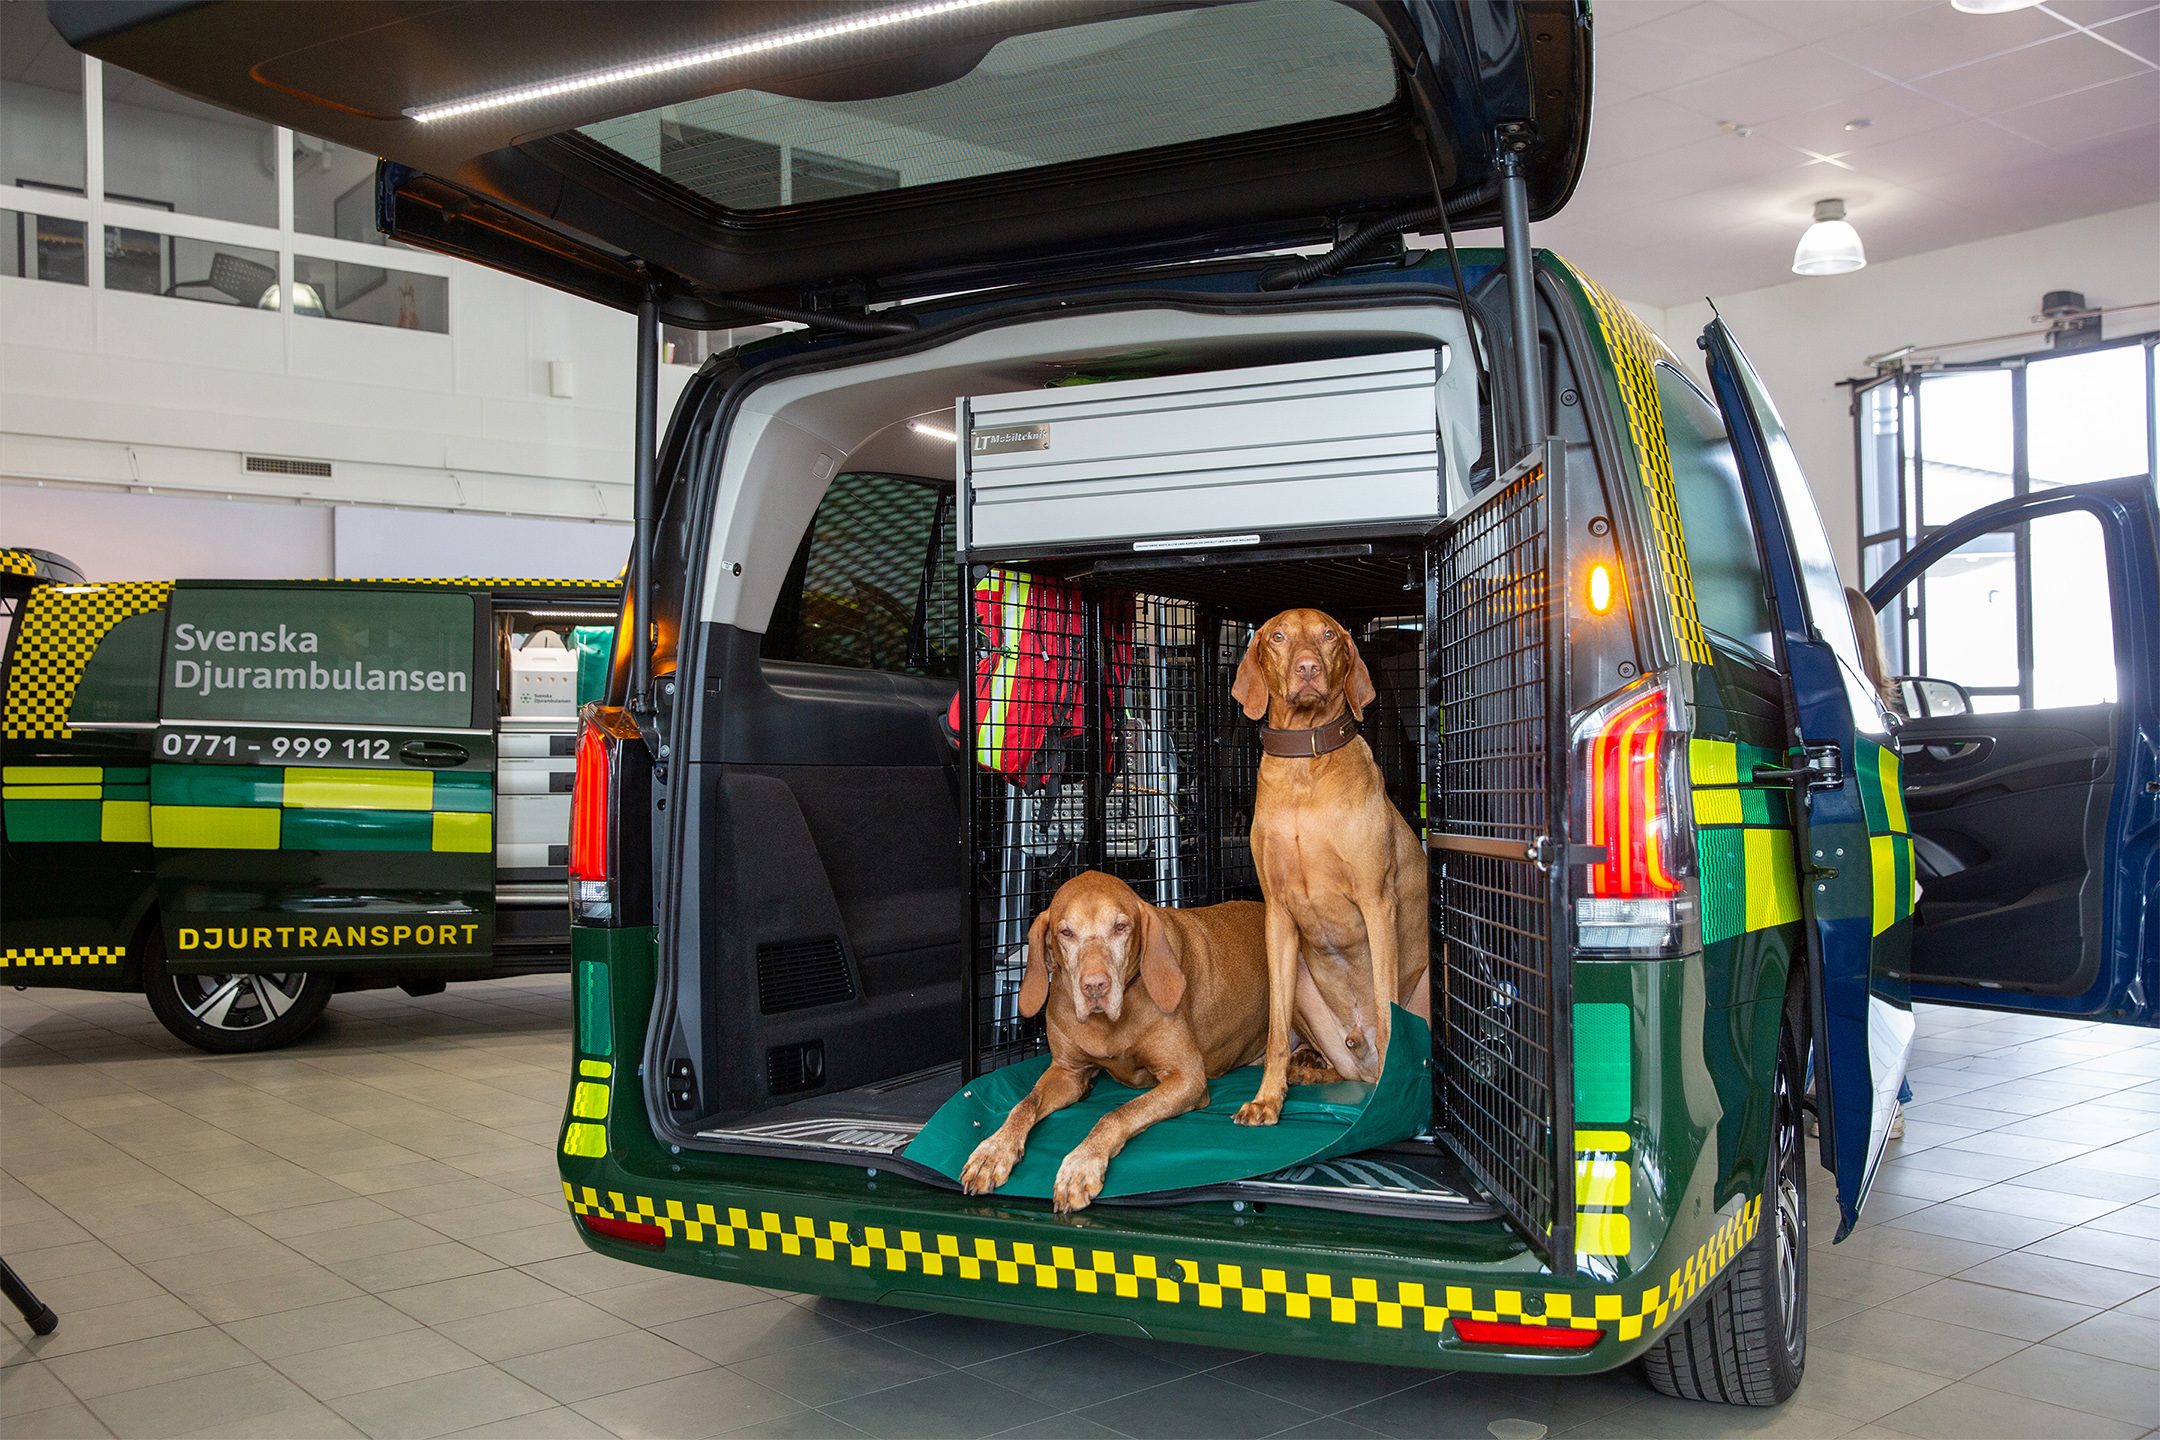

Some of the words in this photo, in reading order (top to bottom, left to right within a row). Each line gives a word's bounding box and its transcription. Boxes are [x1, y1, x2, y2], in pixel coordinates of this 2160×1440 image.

[974, 436, 991, 451] LT
[991, 429, 1047, 444] Mobilteknik
[174, 623, 318, 653] Svenska
[174, 660, 467, 696] Djurambulansen
[162, 733, 237, 757] 0771
[271, 736, 332, 759] 999
[341, 738, 390, 760] 112
[178, 924, 479, 950] DJURTRANSPORT
